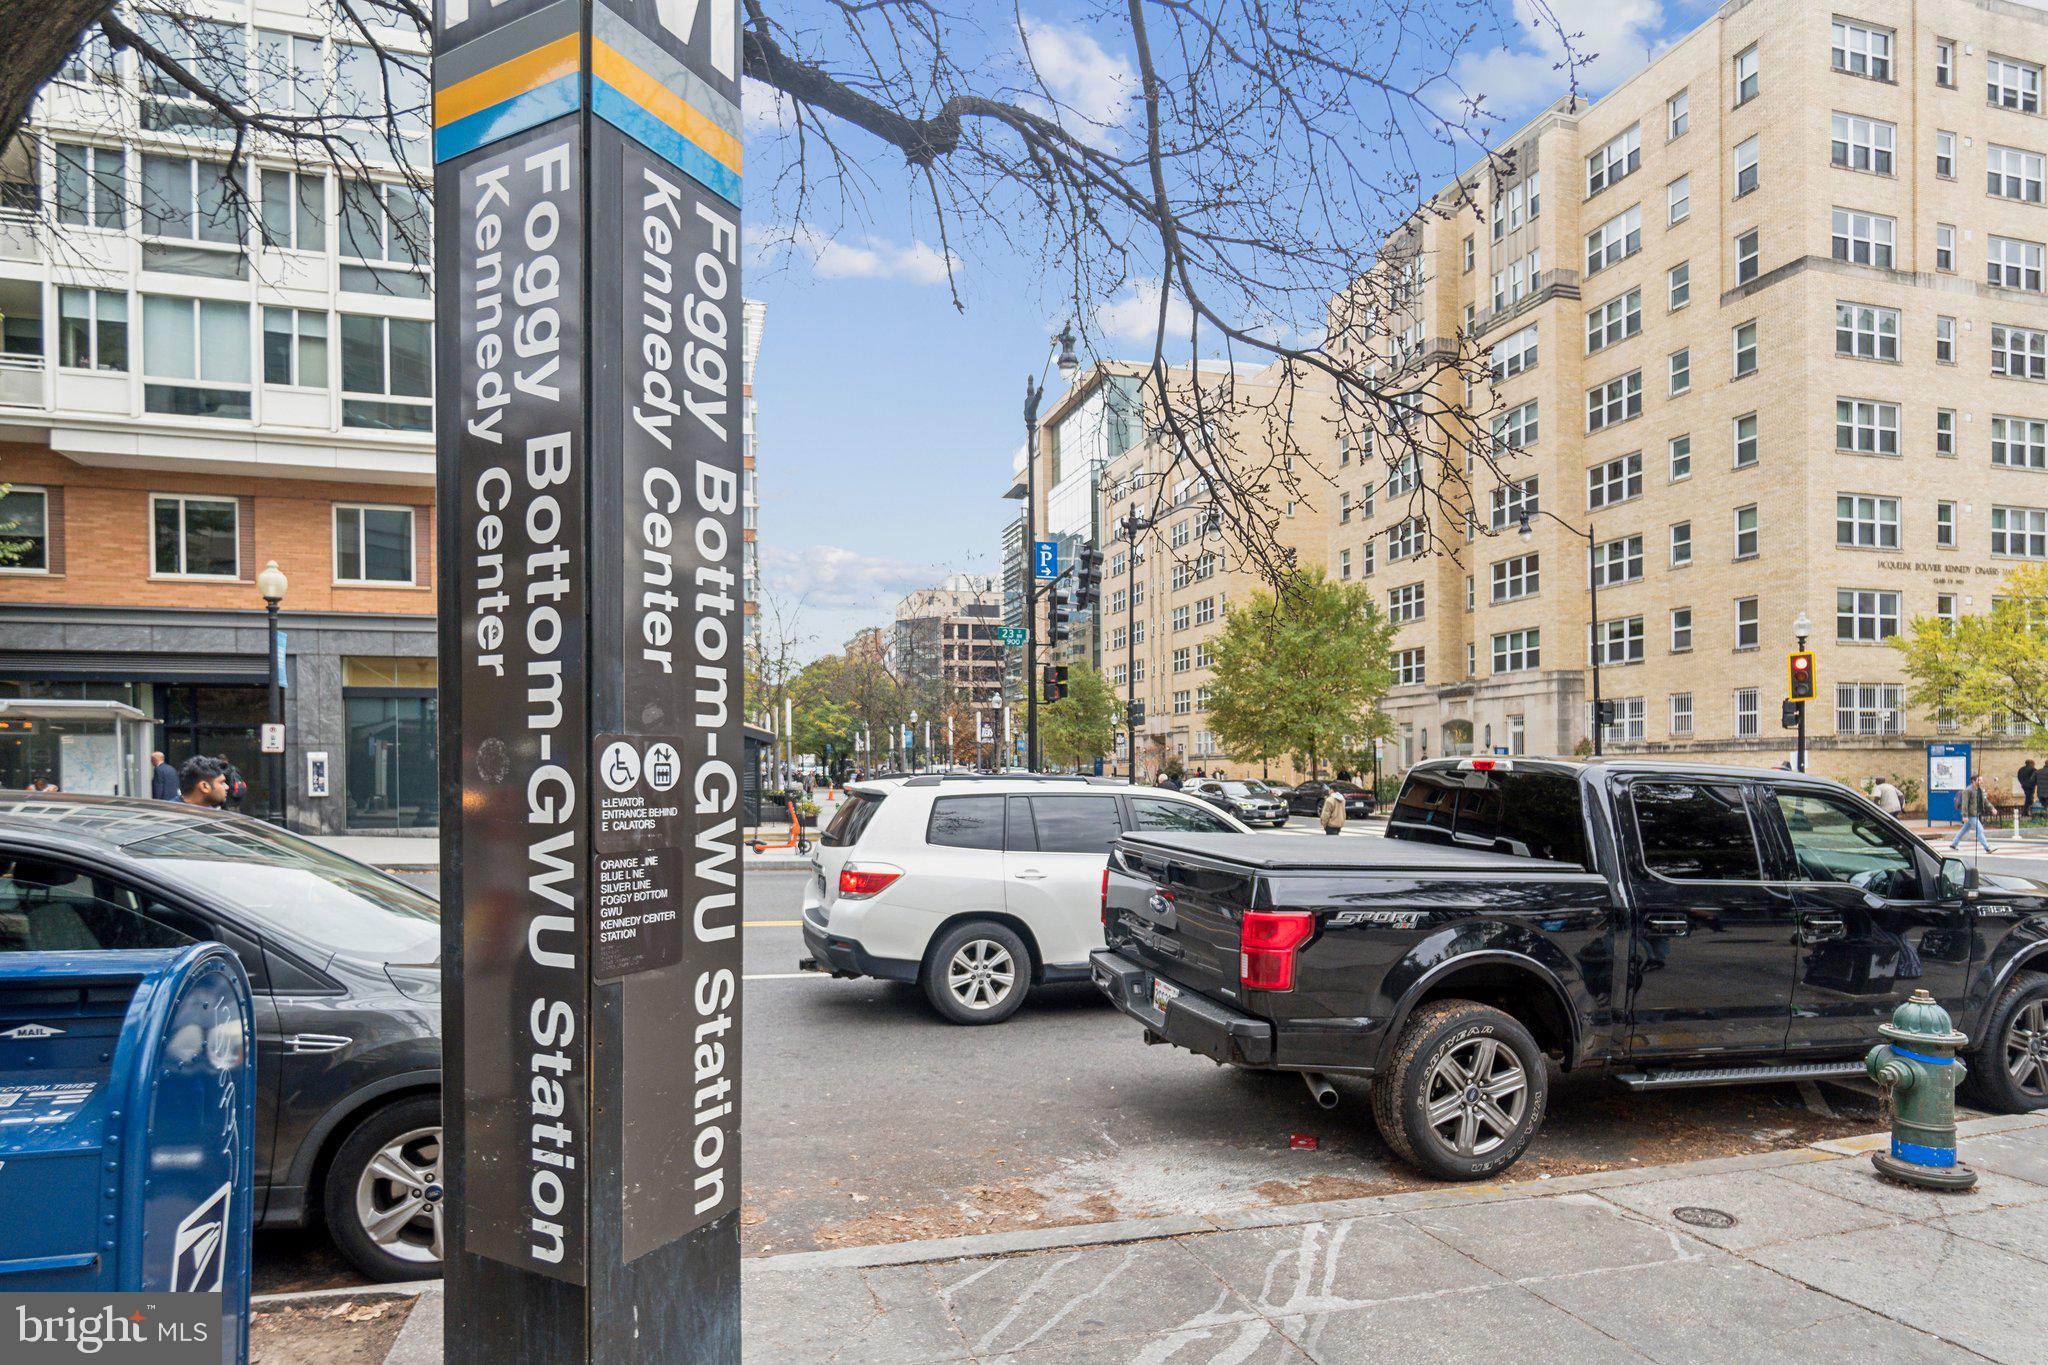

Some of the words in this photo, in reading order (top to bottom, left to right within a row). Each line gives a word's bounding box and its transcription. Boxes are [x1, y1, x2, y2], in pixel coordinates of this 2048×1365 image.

[513, 143, 571, 402] Foggy
[467, 165, 511, 445] Kennedy
[633, 167, 681, 451] Kennedy
[683, 201, 737, 443] Foggy
[1040, 551, 1052, 566] P
[476, 467, 512, 677] Center
[642, 466, 682, 674] Center
[1002, 629, 1014, 638] 23
[526, 431, 576, 969] Bottom-GWU
[693, 459, 738, 943] Bottom-GWU
[602, 797, 645, 808] ELEVATOR
[602, 808, 648, 820] ENTRANCE
[648, 807, 678, 817] BEHIND
[602, 820, 656, 832] ECALATORS
[600, 858, 638, 870] ORANGE
[640, 856, 659, 867] INE
[601, 870, 624, 882] BLUE
[625, 869, 645, 879] LNE
[600, 882, 631, 894] SILVER
[632, 880, 652, 890] LINE
[601, 893, 633, 906] FOGGY
[633, 889, 668, 902] BOTTOM
[600, 906, 623, 918] GWU
[1326, 911, 1430, 926] SPORT
[600, 916, 642, 930] KENNEDY
[642, 911, 676, 924] CENTER
[600, 928, 637, 943] STATION
[17, 1028, 46, 1037] MAIL
[51, 1082, 98, 1090] TIMES
[693, 968, 735, 1216] Station
[530, 997, 575, 1264] Station
